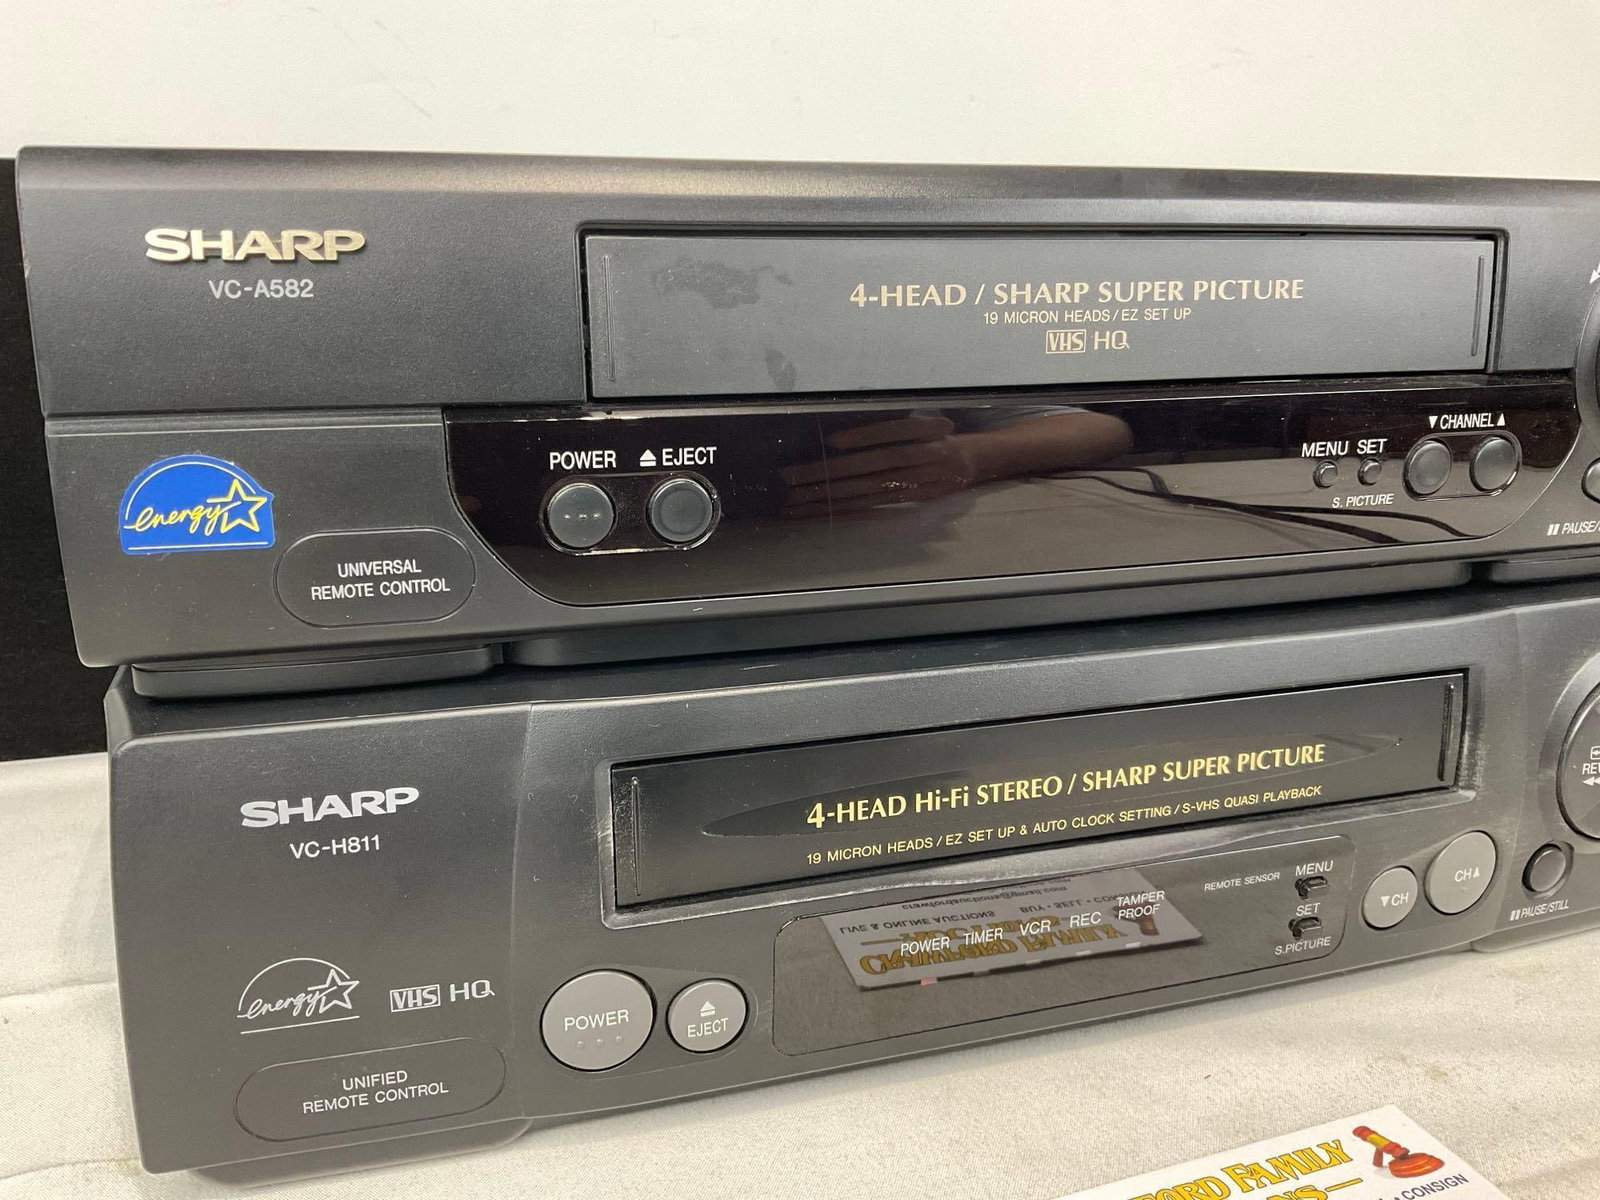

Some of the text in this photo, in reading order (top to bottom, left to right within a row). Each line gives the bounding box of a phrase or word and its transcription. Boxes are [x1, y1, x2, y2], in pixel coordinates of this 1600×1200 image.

[144, 228, 366, 263] SHARP
[208, 278, 315, 299] VC-A582
[850, 282, 967, 308] 4-HEAD
[993, 281, 1090, 305] SHARP
[1098, 280, 1185, 303] SUPER
[1193, 278, 1305, 301] PICTURE
[983, 312, 998, 325] 19
[1004, 310, 1060, 325] MICRON
[1144, 308, 1170, 321] SET
[1174, 307, 1192, 321] UP
[1046, 329, 1130, 354] VHS HQ
[1439, 413, 1495, 430] CHANNEL
[662, 446, 717, 466] EJECT
[1301, 438, 1388, 458] MENU SET
[549, 450, 617, 470] POWER
[1346, 494, 1395, 508] PICTURE
[1561, 519, 1600, 535] PAUSE/
[337, 559, 421, 578] UNIVERSAL
[310, 578, 450, 601] REMOTE CONTROL
[1582, 762, 1600, 775] RE
[806, 794, 907, 829] 4-HEAD
[915, 785, 970, 814] Hi-Fi
[976, 774, 1063, 806] STEREO
[1082, 764, 1158, 793] SHARP
[1162, 755, 1230, 783] SUPER
[1236, 743, 1326, 773] PICTURE
[240, 787, 420, 828] SHARP
[806, 851, 822, 866] 19
[827, 843, 882, 862] MICRON
[968, 827, 993, 843] SET
[998, 825, 1017, 840] UP
[1020, 823, 1029, 837] &
[1033, 818, 1067, 835] AUTO
[1071, 812, 1115, 829] CLOCK
[1224, 793, 1259, 810] QUASI
[1262, 785, 1322, 804] PLAYBACK
[290, 834, 381, 859] VC-H811
[1295, 860, 1334, 876] MENU
[1454, 869, 1472, 883] CH
[1204, 871, 1280, 892] REMOTE SENSOR
[1116, 890, 1165, 908] TAMPER
[1391, 891, 1409, 906] CH
[1520, 899, 1569, 919] PAUSE/STILL
[1117, 903, 1161, 921] PROOF
[1296, 902, 1321, 917] SET
[900, 935, 950, 957] POWER
[963, 926, 1003, 946] TIMER
[1019, 920, 1052, 936] VCR
[1069, 912, 1102, 929] REC
[1274, 936, 1332, 956] S.PICTURE
[390, 979, 496, 1013] VHS HQ
[563, 1010, 630, 1032] POWER
[686, 1017, 729, 1038] EJECT
[342, 1070, 408, 1091] UNIFIED
[302, 1081, 449, 1115] REMOTE CONTROL
[1220, 1139, 1354, 1194] FAMILY
[1401, 1173, 1470, 1200] CONSIGN
